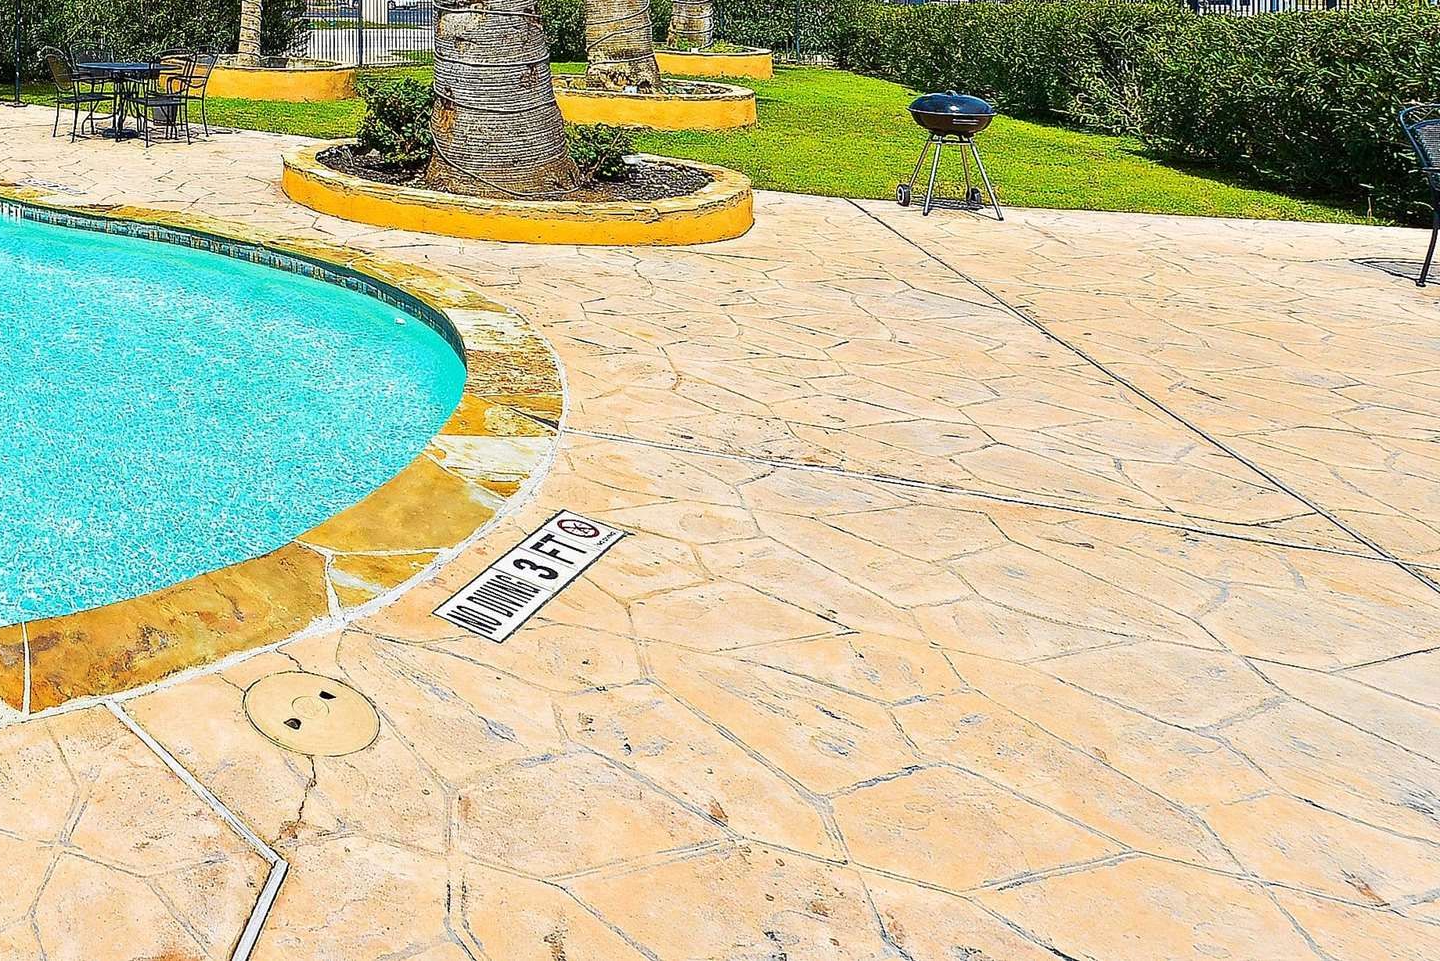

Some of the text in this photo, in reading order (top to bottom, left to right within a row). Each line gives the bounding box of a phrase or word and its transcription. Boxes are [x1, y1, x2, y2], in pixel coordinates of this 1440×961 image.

[446, 534, 587, 635] NO DIVING 3 FT
